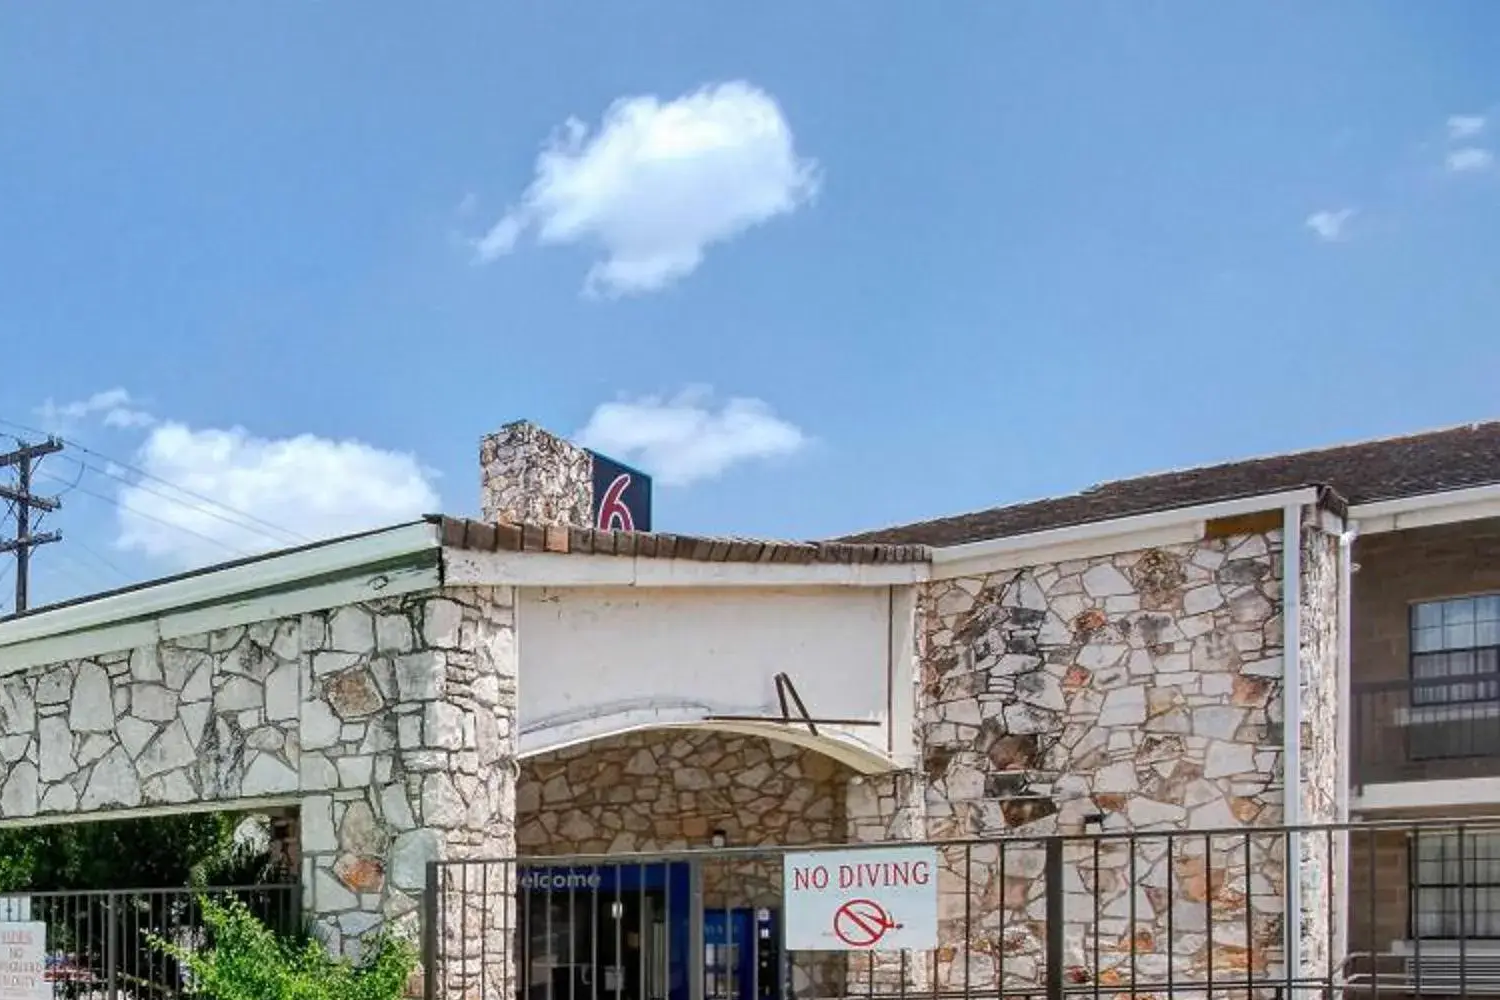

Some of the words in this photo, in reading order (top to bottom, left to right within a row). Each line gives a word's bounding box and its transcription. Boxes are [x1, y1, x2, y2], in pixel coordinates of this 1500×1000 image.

[597, 473, 635, 532] 6
[521, 872, 601, 889] elcome
[794, 866, 829, 891] NO
[839, 861, 930, 889] DIVING
